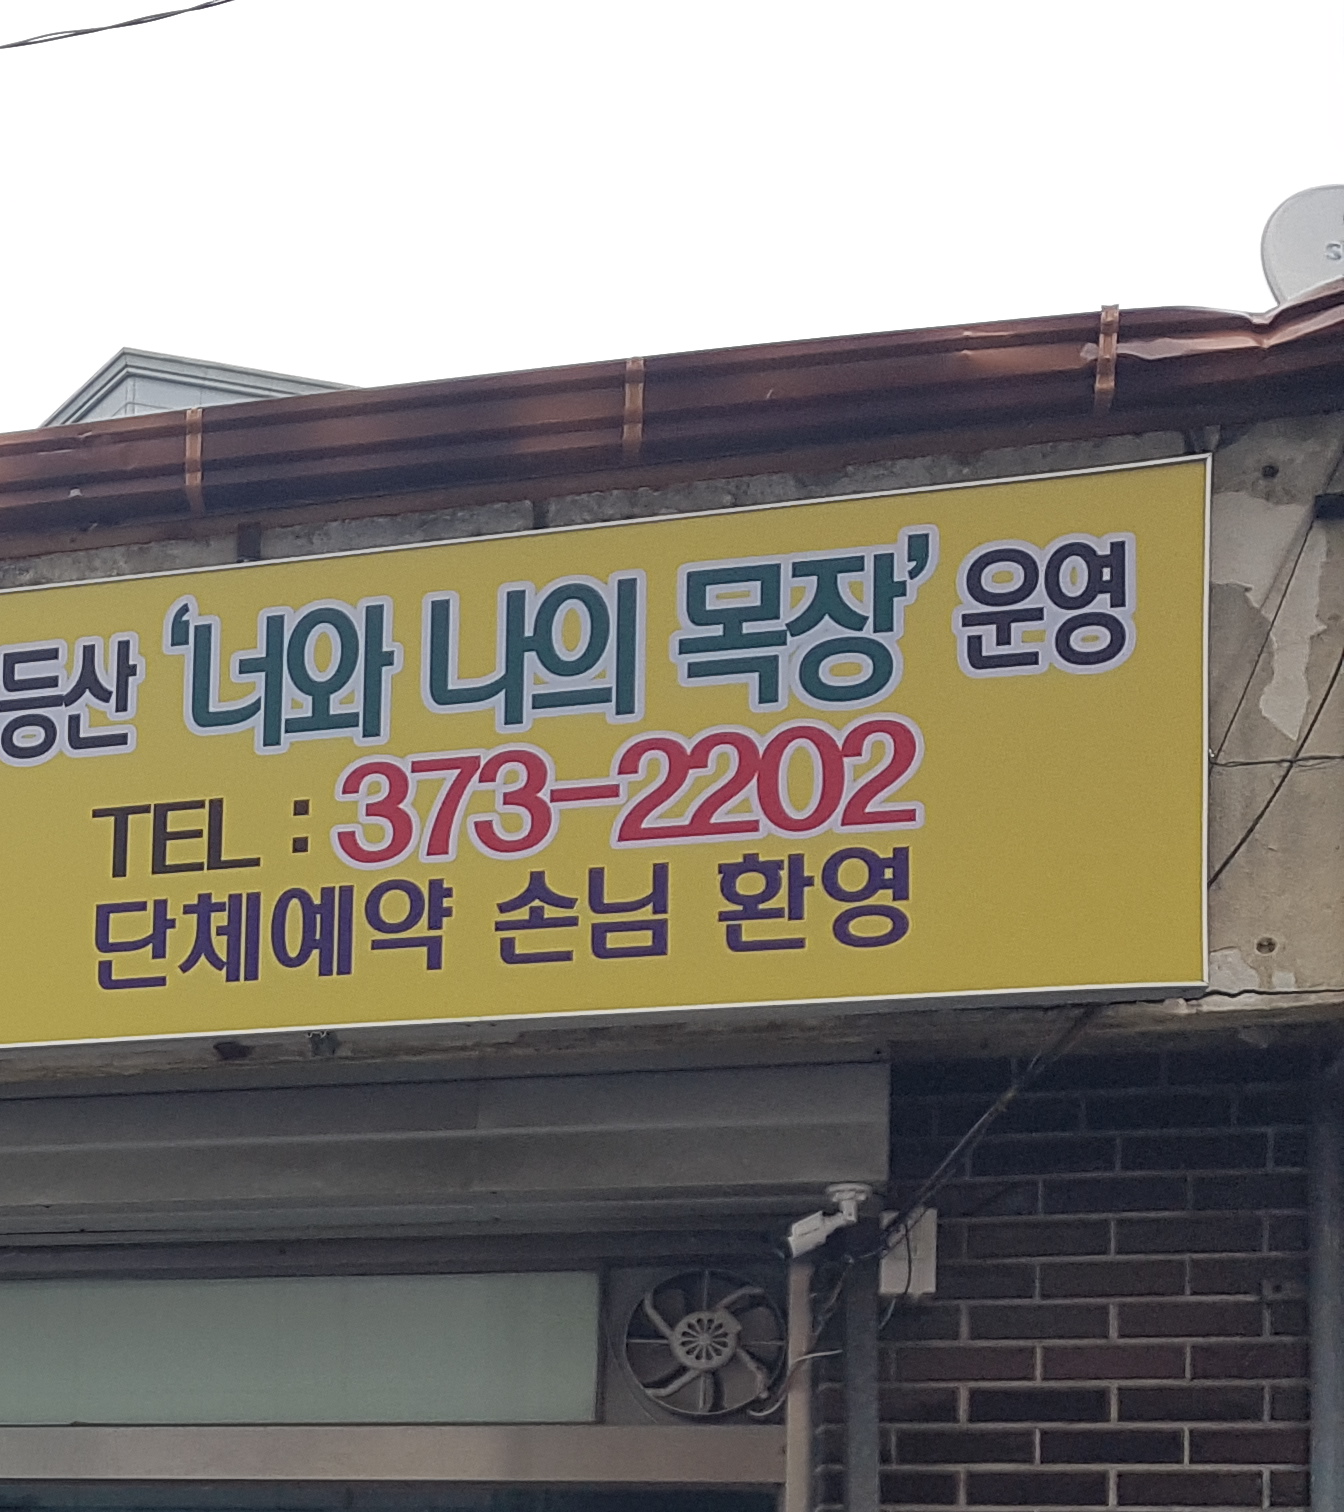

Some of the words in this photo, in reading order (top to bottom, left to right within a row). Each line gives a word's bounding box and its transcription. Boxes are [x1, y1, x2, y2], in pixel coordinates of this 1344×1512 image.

[422, 571, 644, 733] 나의
[955, 533, 1134, 677] 운영
[332, 716, 923, 868] 373-2202
[93, 876, 453, 990] 단체예약
[494, 859, 670, 966] 손님
[717, 843, 911, 951] 환영
